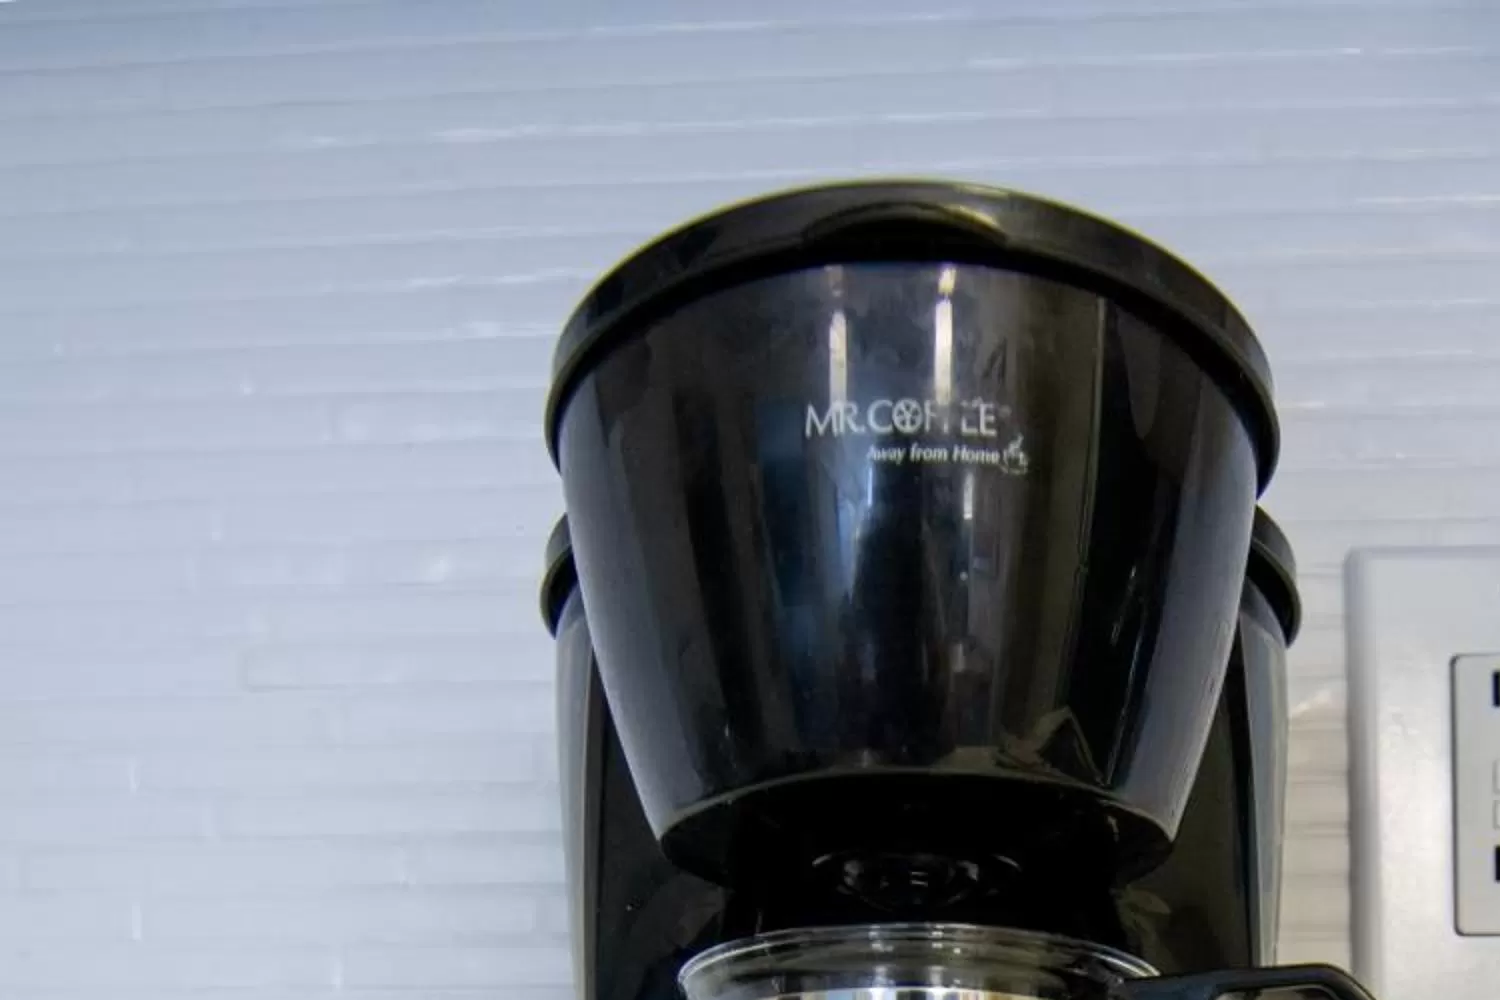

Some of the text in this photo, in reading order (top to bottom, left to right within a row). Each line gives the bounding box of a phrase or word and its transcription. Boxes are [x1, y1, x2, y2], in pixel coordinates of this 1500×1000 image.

[867, 398, 998, 437] COFEE
[910, 442, 949, 463] from
[953, 445, 1000, 464] Home
